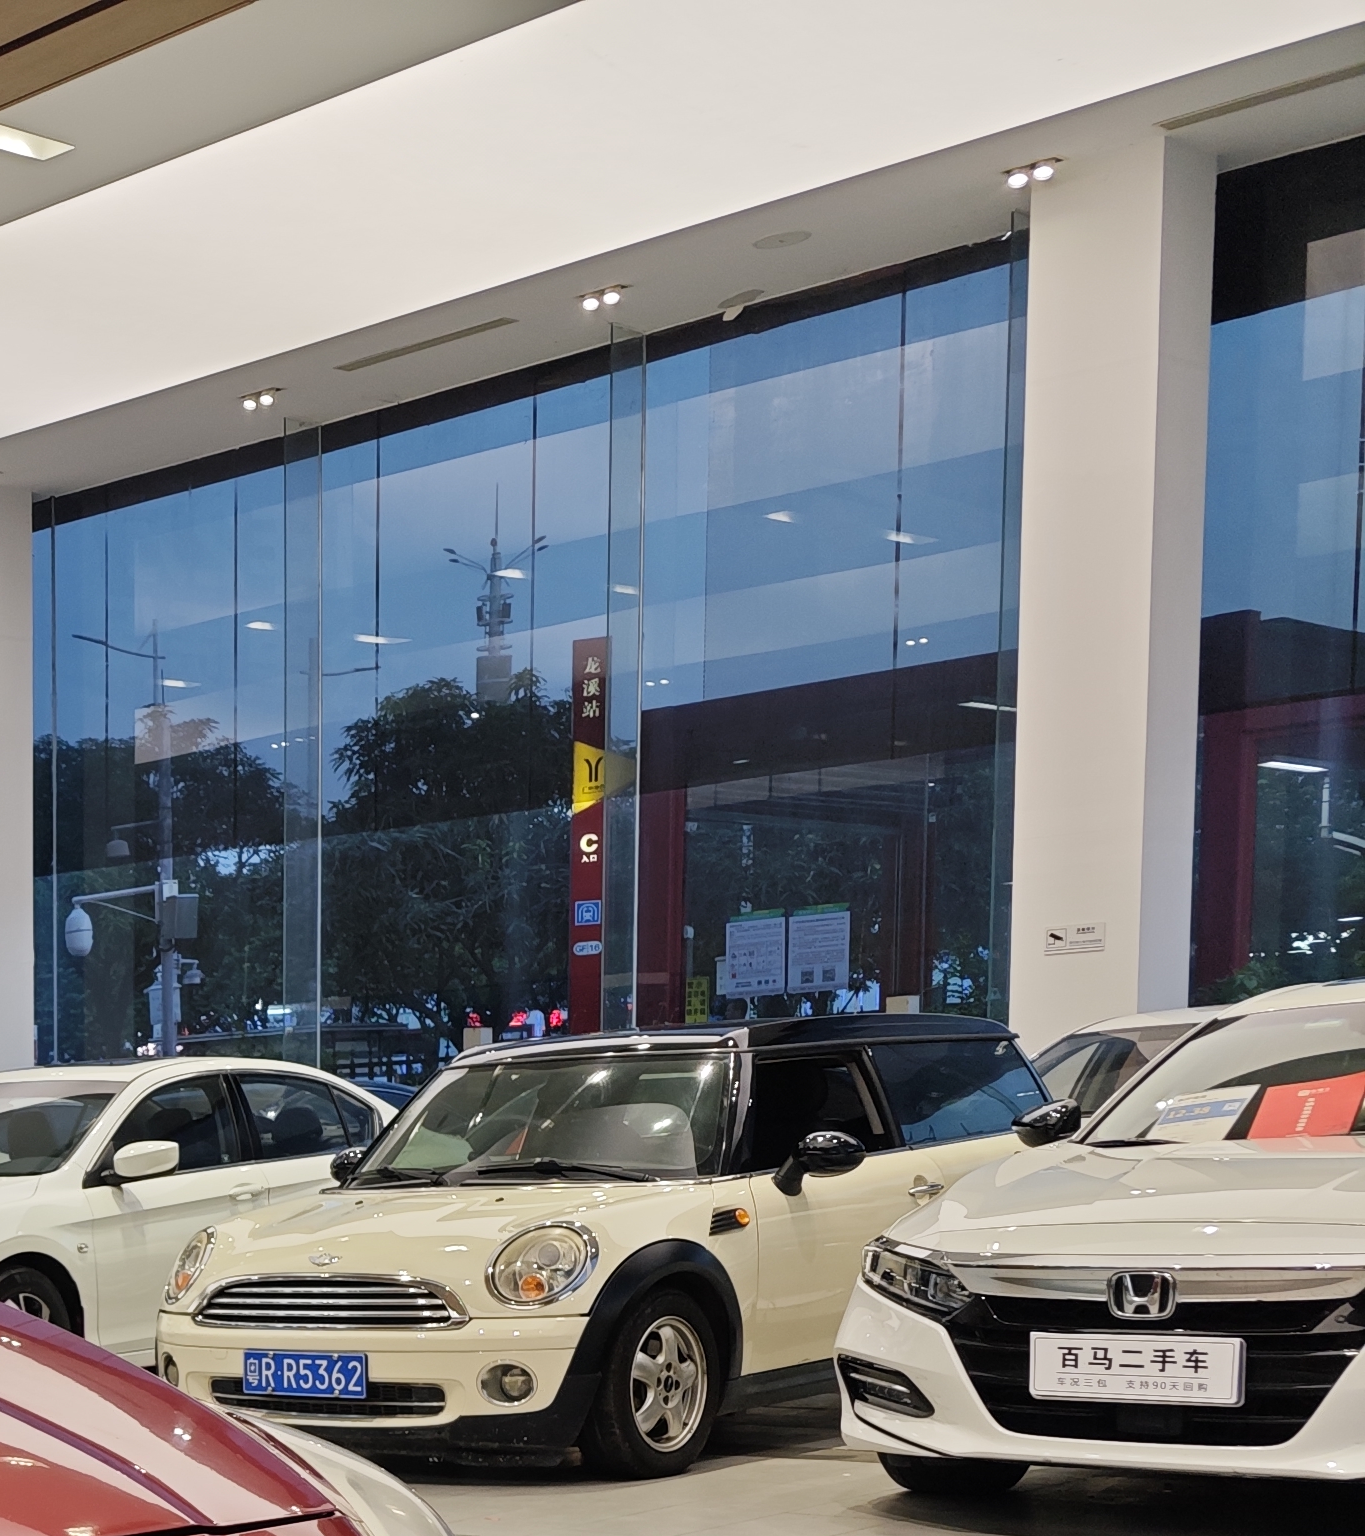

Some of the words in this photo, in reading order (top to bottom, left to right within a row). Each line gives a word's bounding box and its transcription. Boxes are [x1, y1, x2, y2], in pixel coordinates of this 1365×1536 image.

[582, 656, 602, 718] 龙溪站
[579, 833, 599, 853] C
[581, 854, 598, 863] 入口
[1057, 1346, 1209, 1374] 百马二手车
[1056, 1377, 1108, 1388] 车况三包
[1125, 1379, 1208, 1393] 支持90天回购
